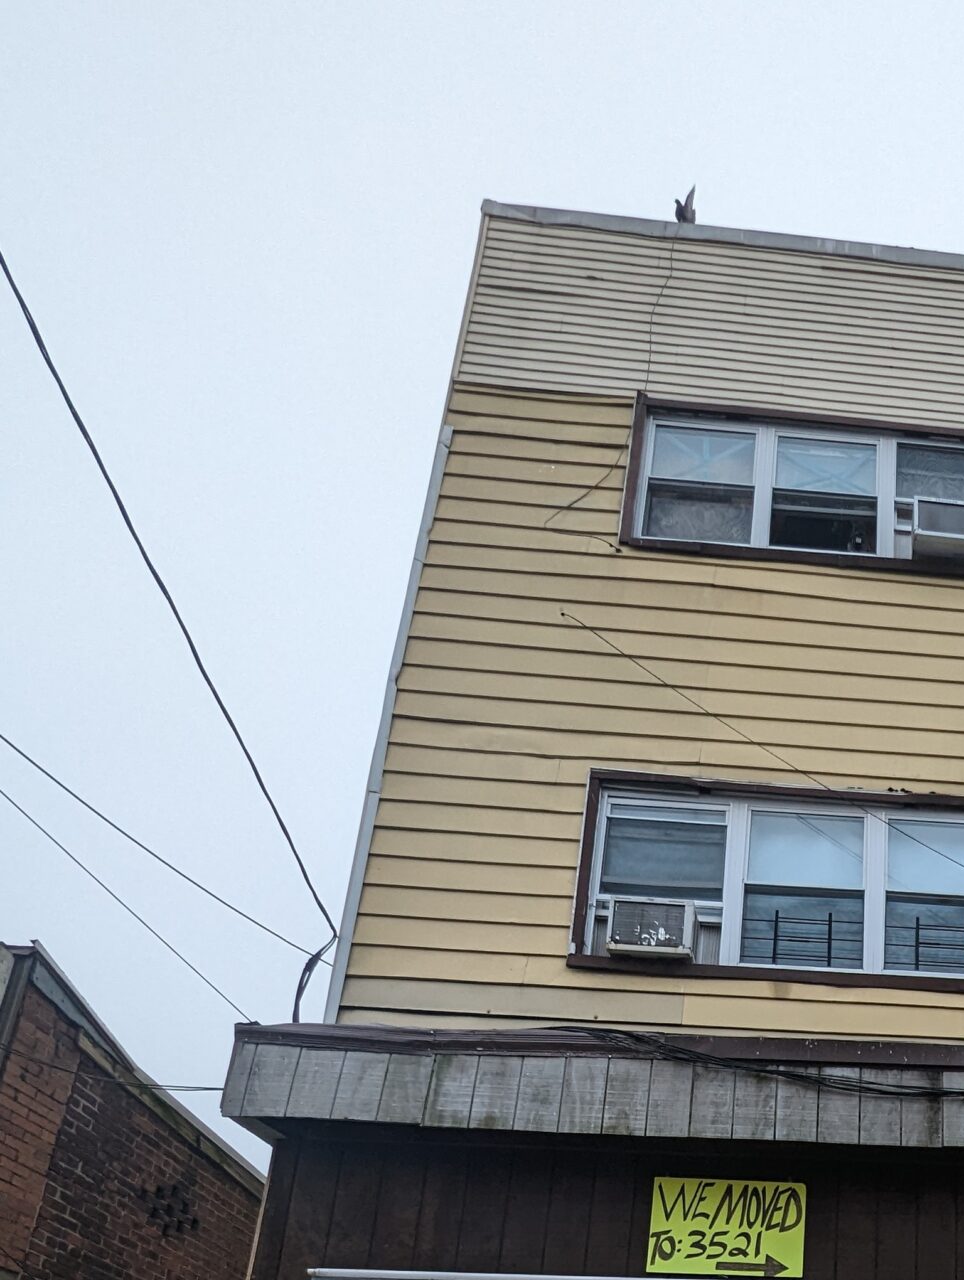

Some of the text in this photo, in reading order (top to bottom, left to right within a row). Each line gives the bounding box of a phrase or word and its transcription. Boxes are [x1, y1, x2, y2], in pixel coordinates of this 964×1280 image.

[658, 1181, 803, 1233] WE MOVED
[650, 1230, 763, 1265] TO: 3521
